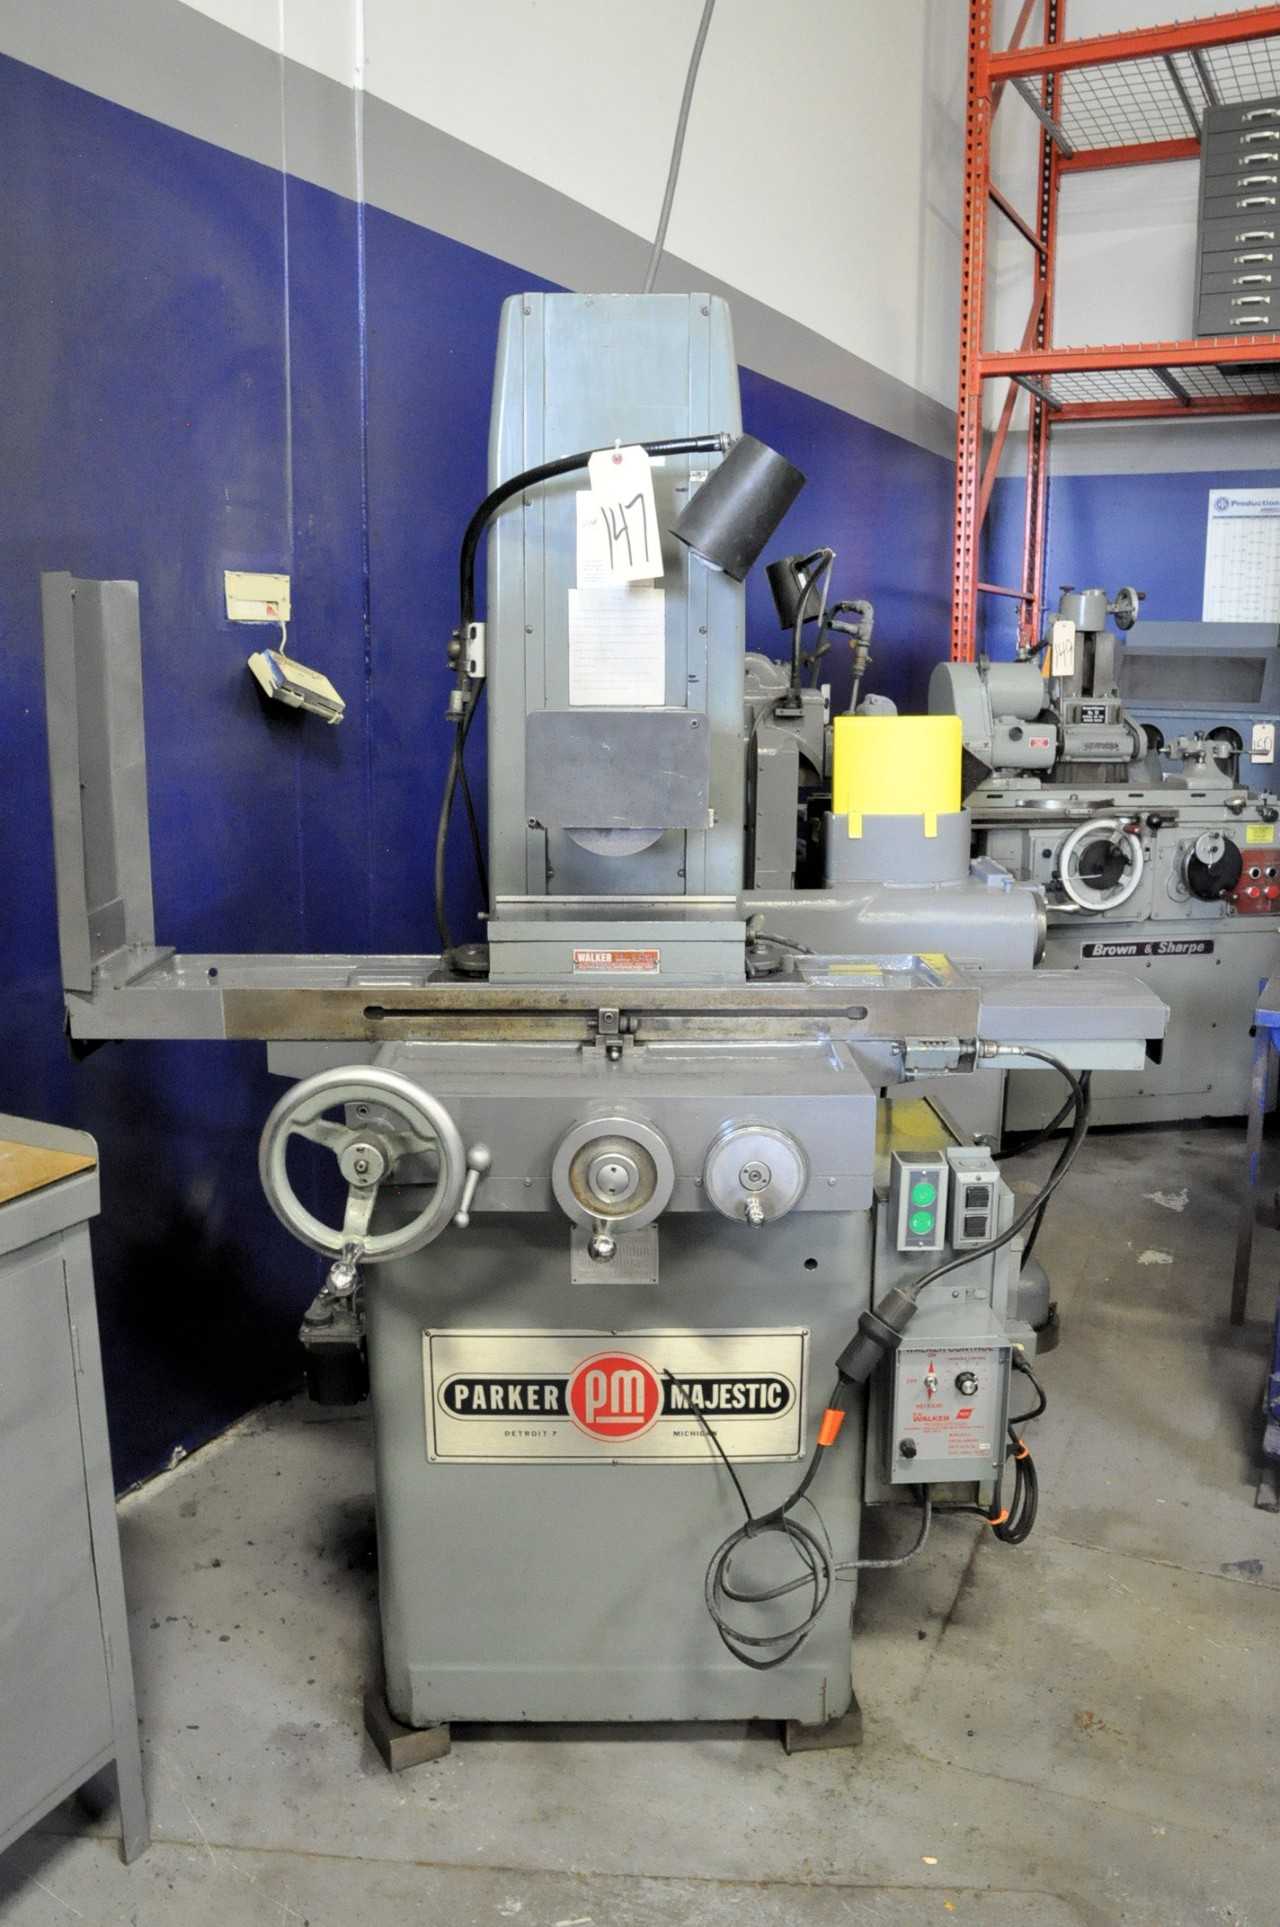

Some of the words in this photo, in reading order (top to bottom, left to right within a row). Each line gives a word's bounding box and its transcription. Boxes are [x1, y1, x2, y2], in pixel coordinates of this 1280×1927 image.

[600, 492, 649, 570] 147
[1092, 942, 1137, 956] Brown
[1144, 943, 1152, 954] &
[1157, 940, 1206, 954] Sharpe
[577, 952, 612, 962] WALKER
[454, 1384, 560, 1411] PARKER
[670, 1382, 783, 1410] MAJESTIC
[913, 1413, 950, 1422] WALKER
